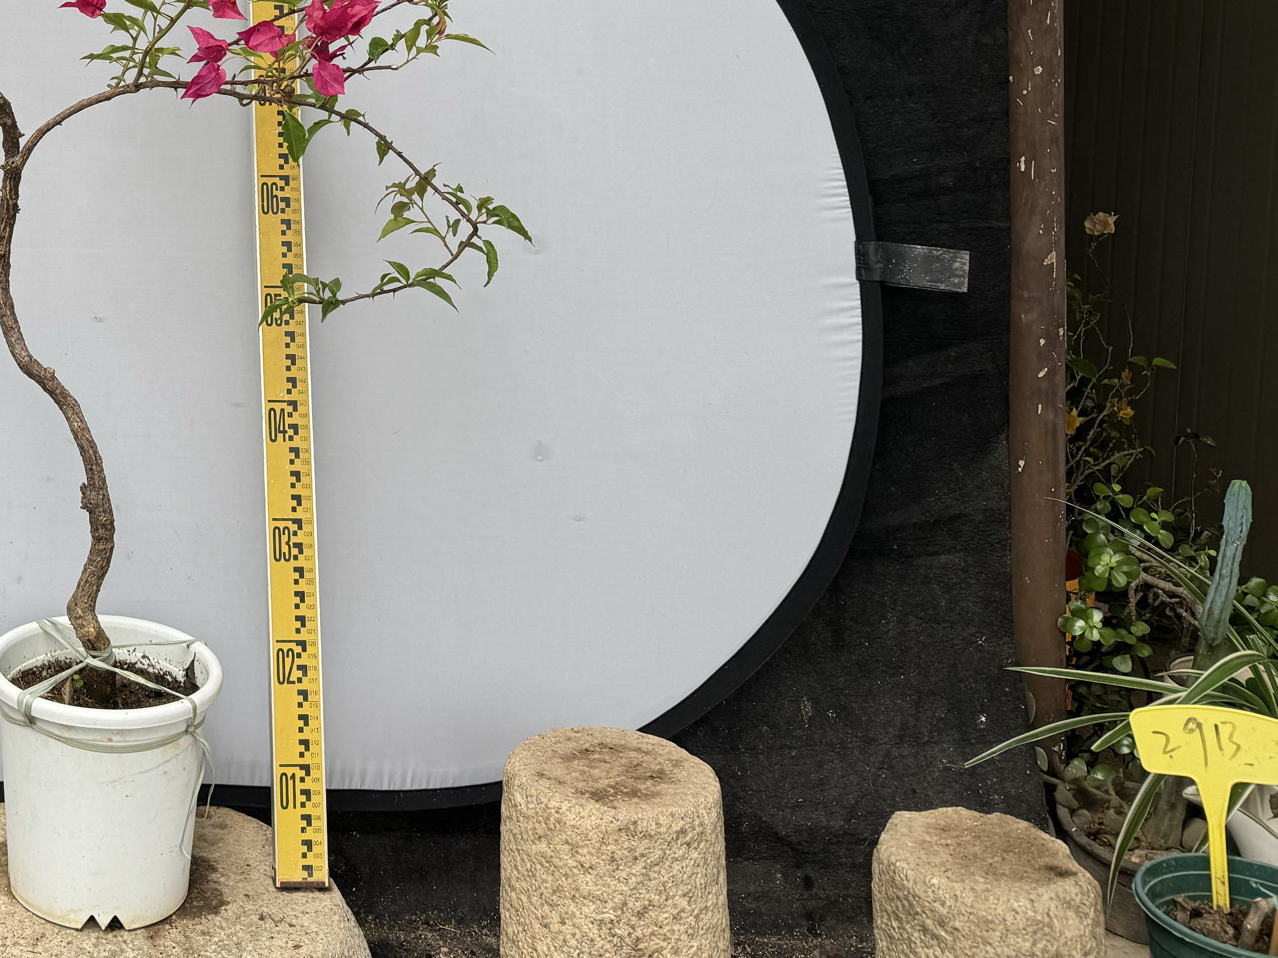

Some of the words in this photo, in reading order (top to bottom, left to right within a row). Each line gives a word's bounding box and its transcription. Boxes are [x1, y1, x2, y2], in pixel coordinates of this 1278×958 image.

[260, 182, 280, 215] 06
[264, 293, 283, 327] 05
[268, 407, 288, 443] 04
[272, 526, 292, 563] 03
[276, 648, 296, 685] 02
[279, 772, 297, 810] 01
